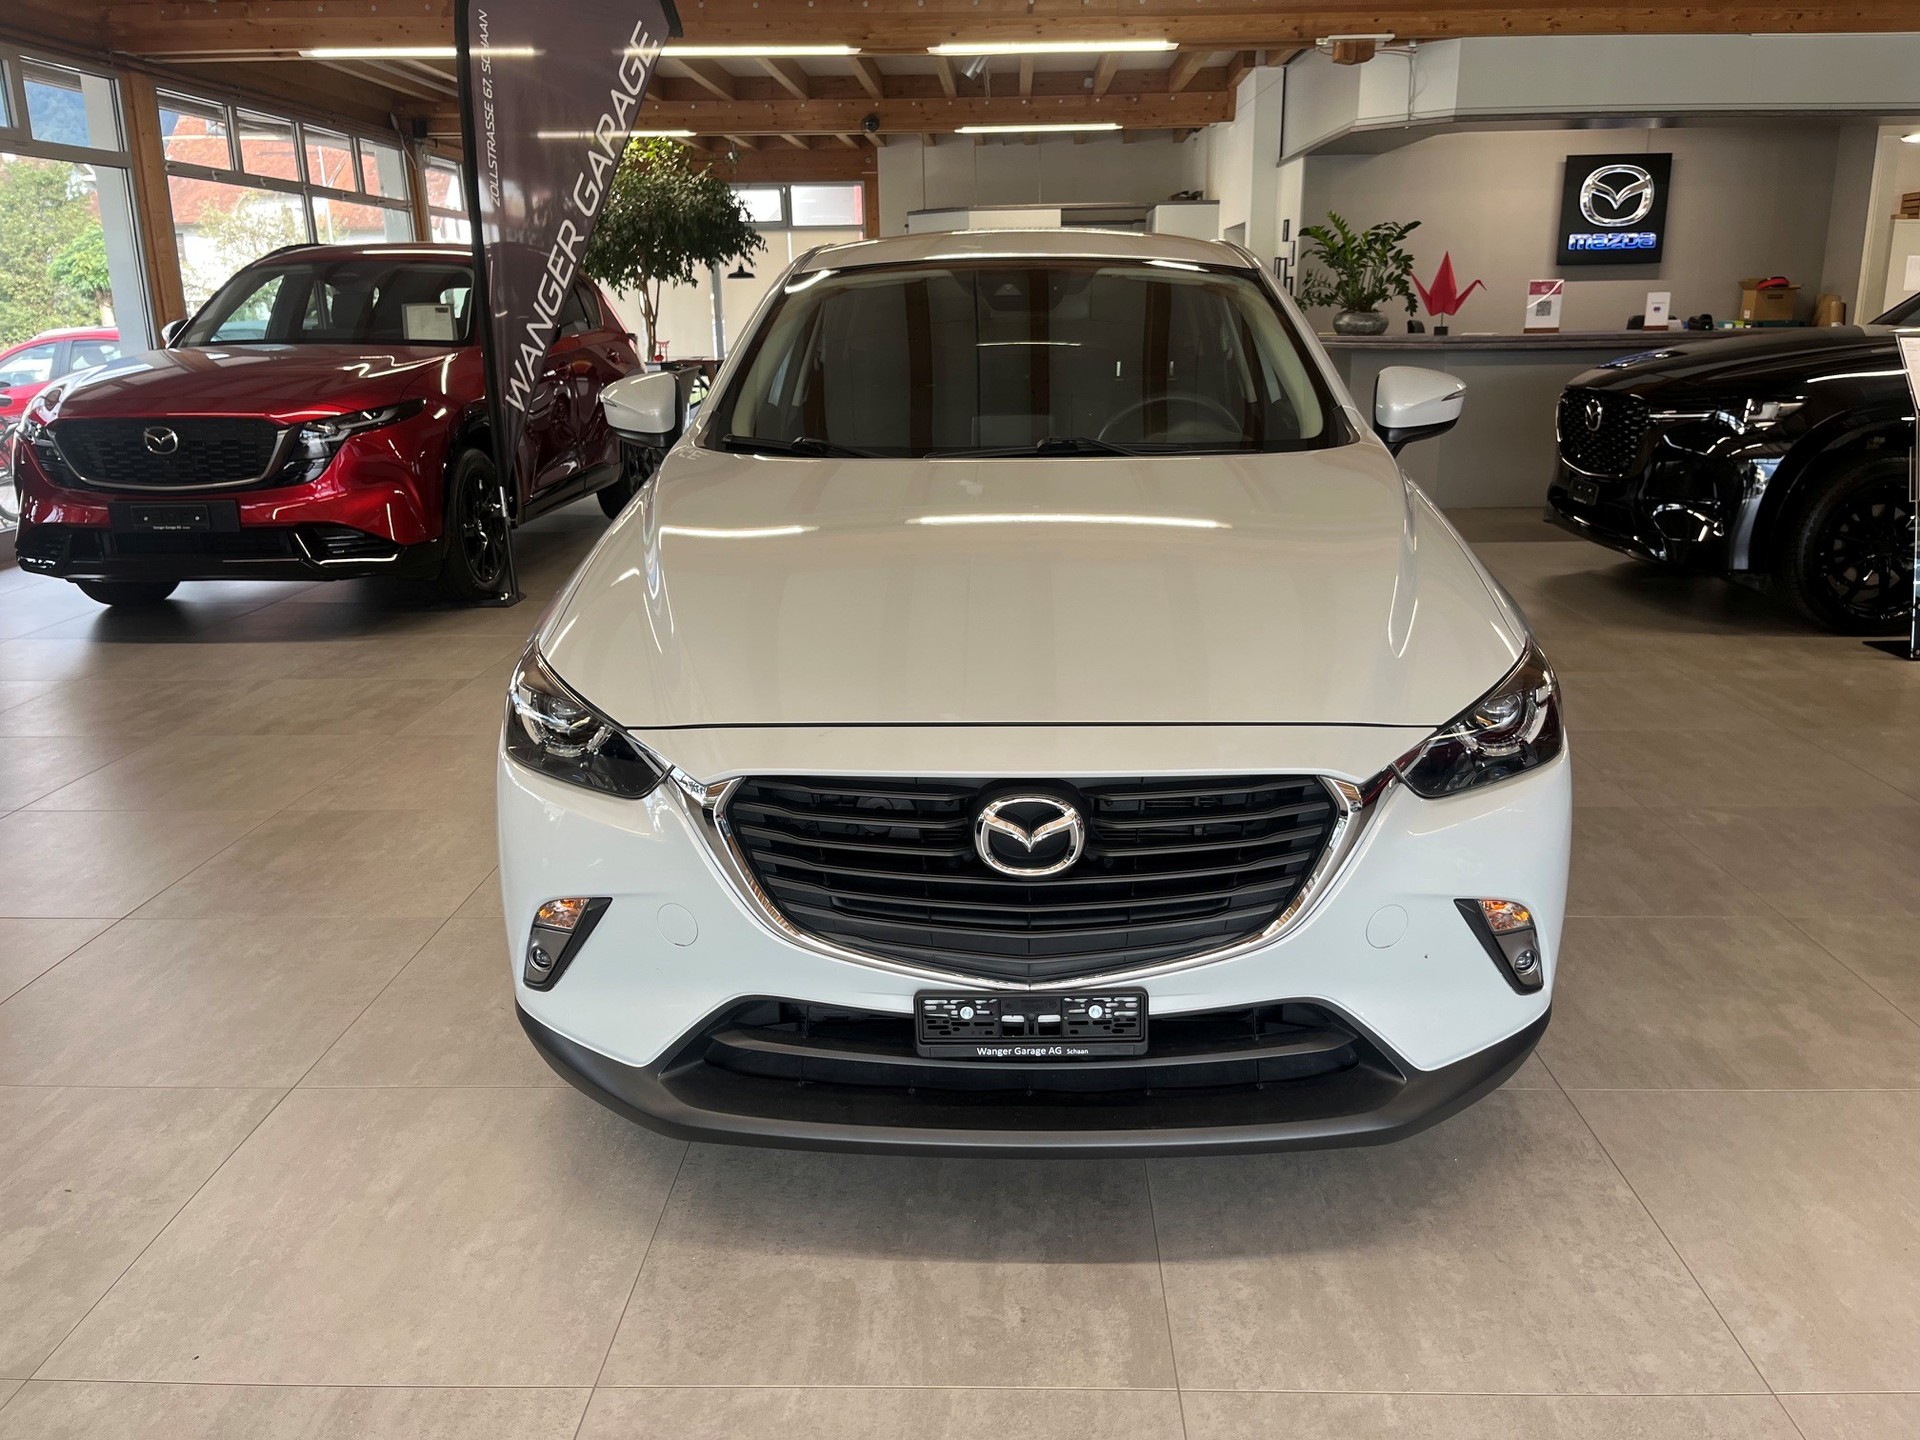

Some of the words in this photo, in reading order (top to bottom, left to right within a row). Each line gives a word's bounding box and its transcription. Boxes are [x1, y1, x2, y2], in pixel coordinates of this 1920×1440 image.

[482, 77, 494, 99] 67,
[484, 100, 501, 208] ZOLLSTRASSE
[506, 219, 585, 411] WANGER
[574, 20, 658, 217] GARAGE
[976, 1046, 1012, 1057] Wanger
[1014, 1047, 1046, 1057] Garage
[1048, 1046, 1062, 1055] AG
